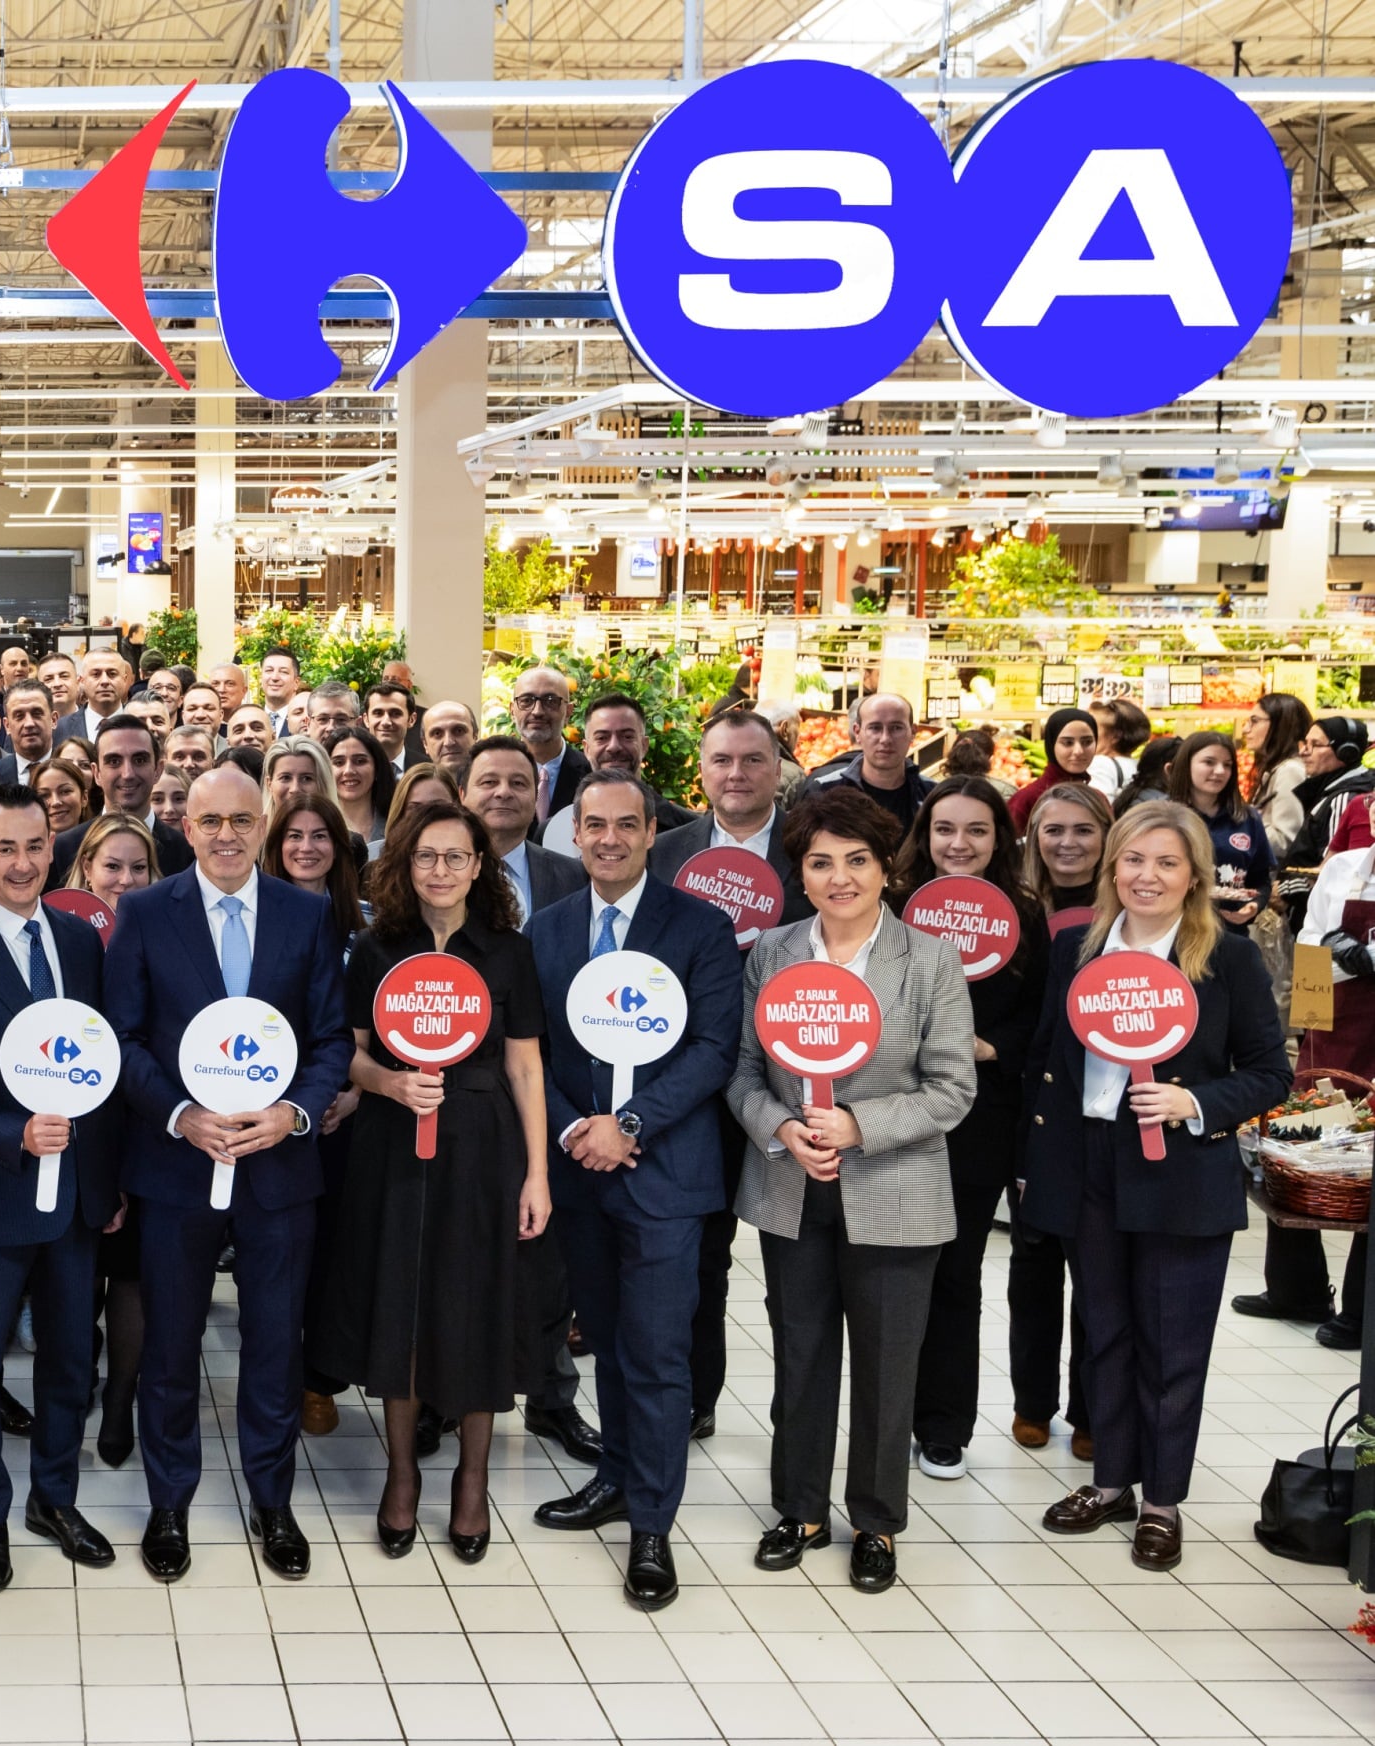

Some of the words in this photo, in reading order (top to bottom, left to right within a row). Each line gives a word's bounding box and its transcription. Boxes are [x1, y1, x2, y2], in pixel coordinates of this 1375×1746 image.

[717, 868, 727, 879] 12
[725, 871, 755, 888] ARALIK
[685, 871, 775, 914] MAĞAZACILAR
[944, 899, 953, 910] 12
[953, 900, 984, 914] ARALIK
[913, 907, 1010, 938] MAĞAZACILAR
[415, 980, 423, 992] 12
[424, 981, 454, 993] ARALIK
[1106, 979, 1116, 991] 12
[1117, 976, 1150, 990] ARALIK
[385, 992, 481, 1014] MAĞAZACILAR
[795, 989, 805, 1001] 12
[805, 989, 838, 1002] ARALIK
[1078, 988, 1185, 1014] MAĞAZACILAR
[765, 1001, 870, 1023] MAĞAZACILAR
[1112, 1010, 1155, 1034] GÜNÜ
[413, 1014, 451, 1035] GÜNÜ
[798, 1023, 839, 1046] GÜNÜ
